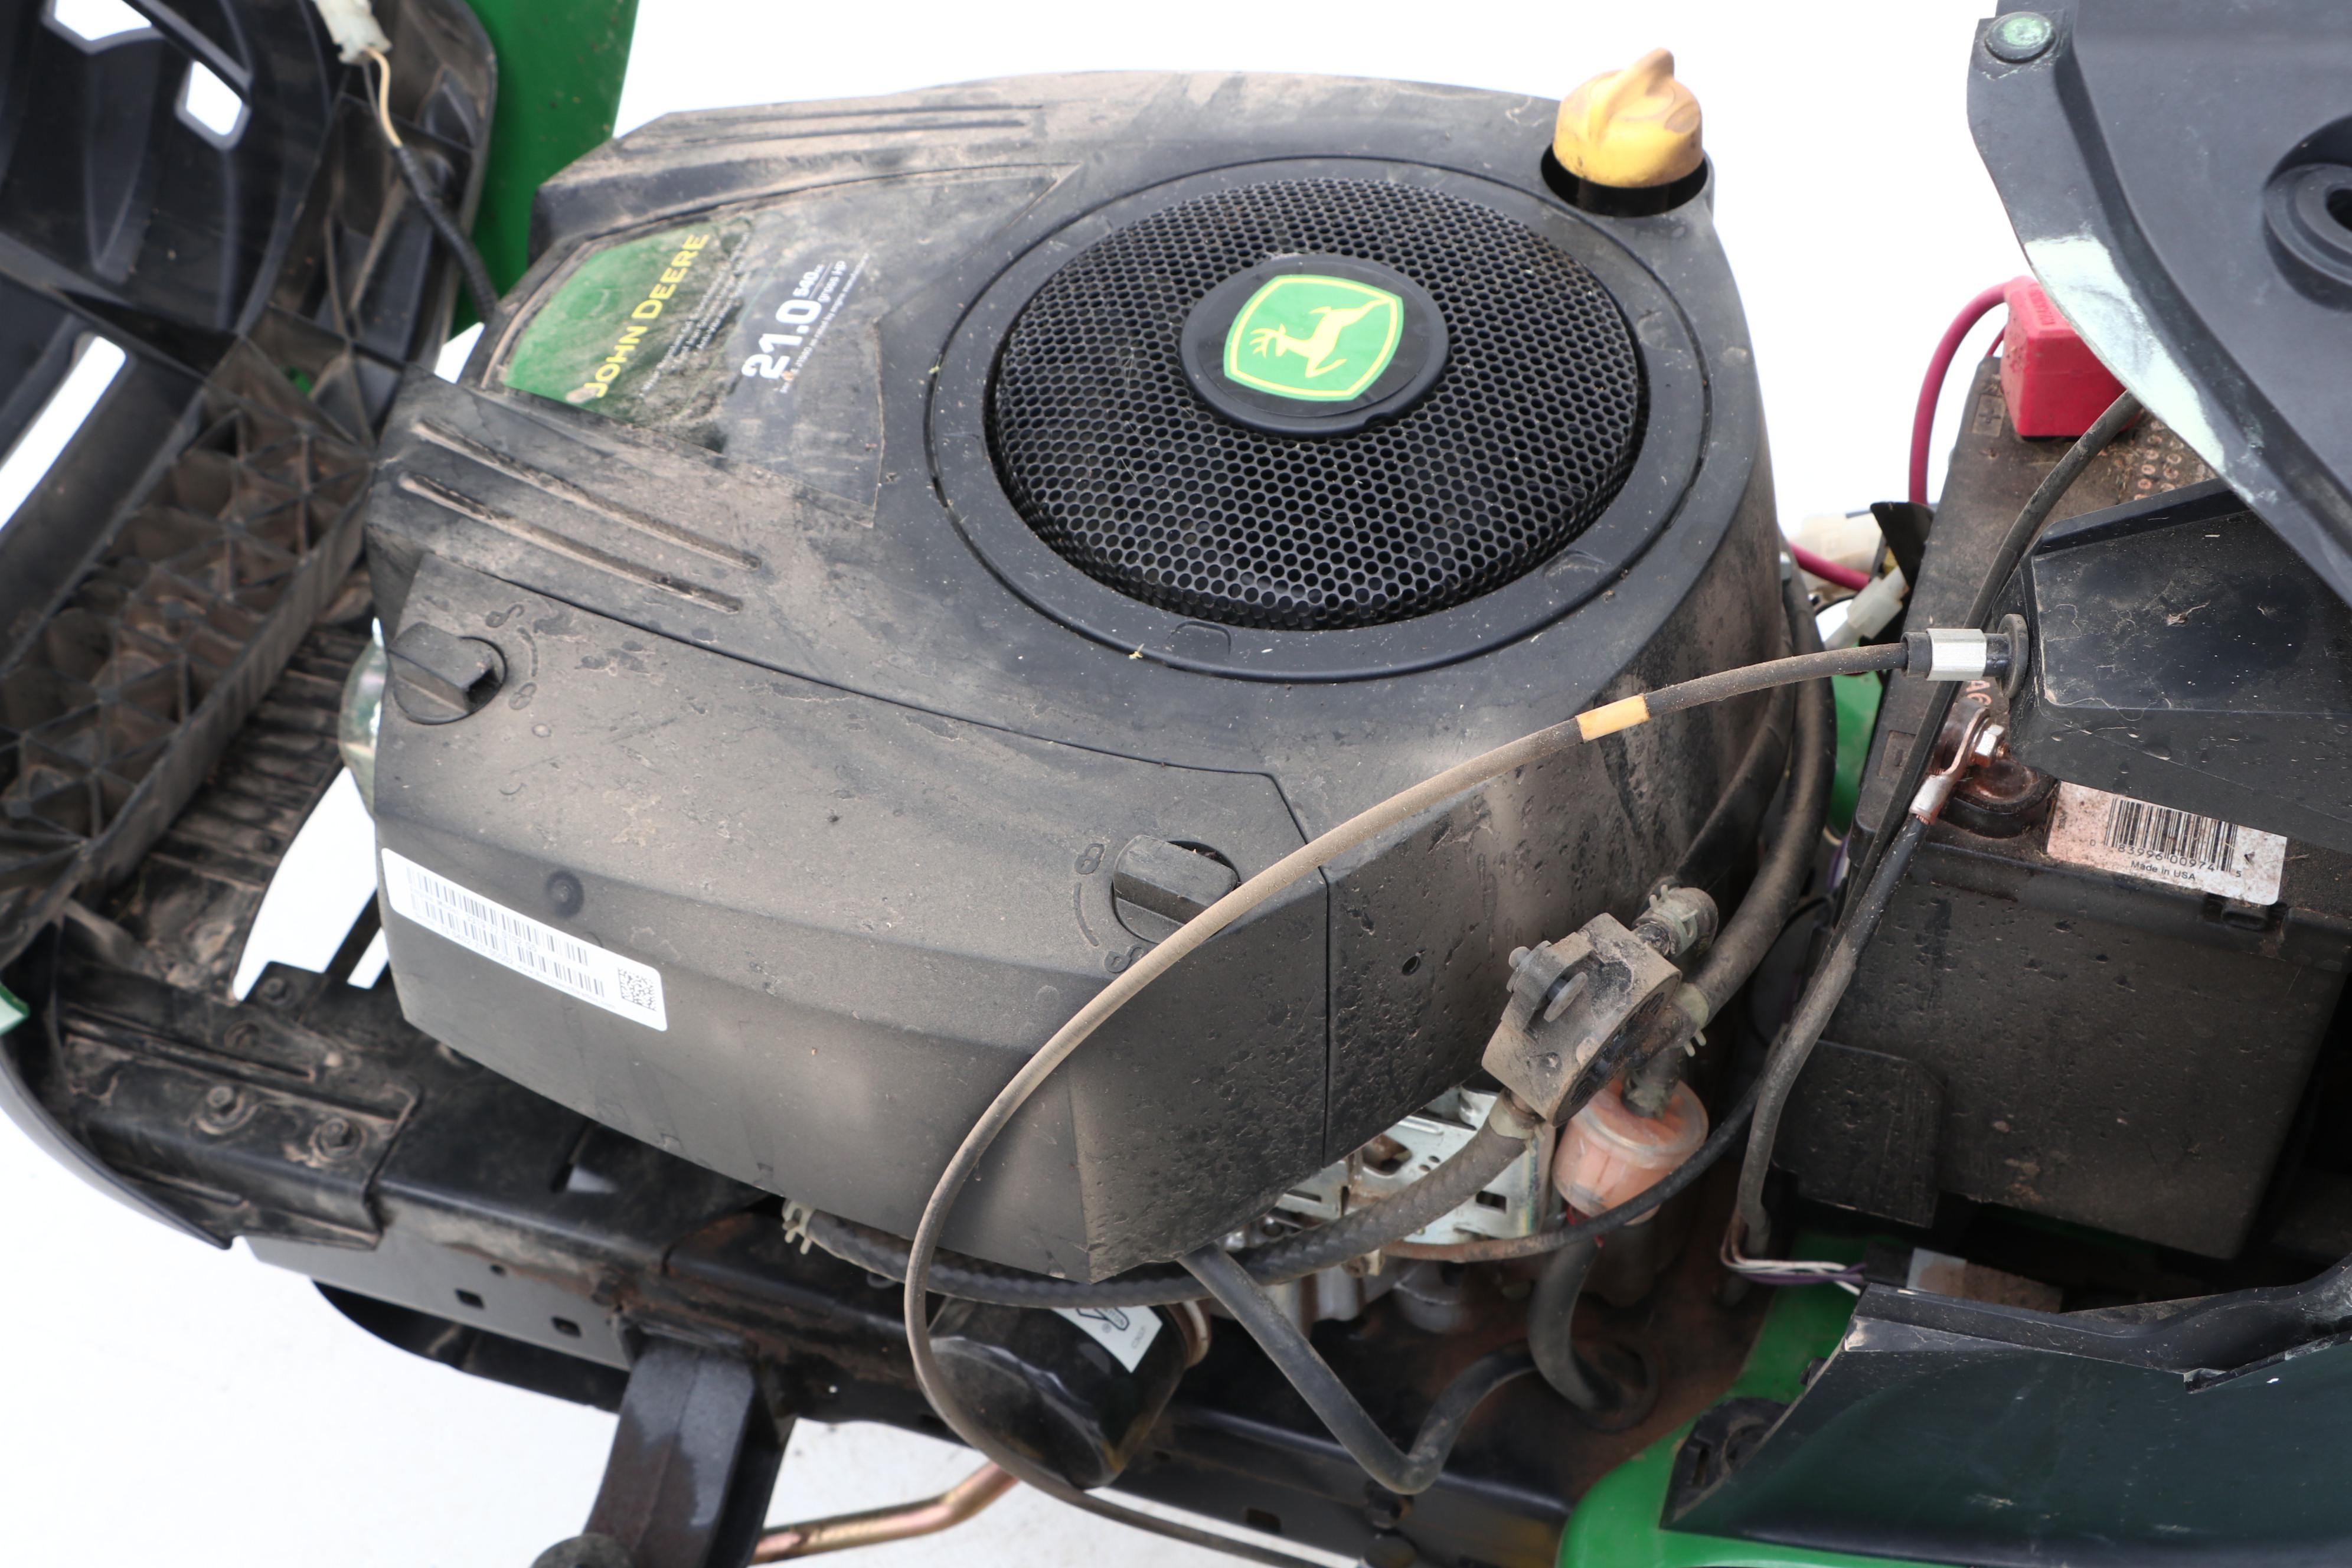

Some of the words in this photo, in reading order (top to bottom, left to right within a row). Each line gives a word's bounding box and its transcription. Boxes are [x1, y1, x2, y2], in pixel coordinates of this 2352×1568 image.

[817, 276, 841, 303] gross
[831, 260, 847, 276] HP
[583, 326, 648, 398] JOHN
[631, 234, 710, 319] DEERE
[741, 299, 822, 380] 21.0
[2089, 838, 2096, 847] 0
[2117, 843, 2163, 861] 83996
[2169, 854, 2215, 872] 00974
[2130, 860, 2158, 873] Made
[2161, 867, 2170, 876] in
[2173, 870, 2196, 881] USA
